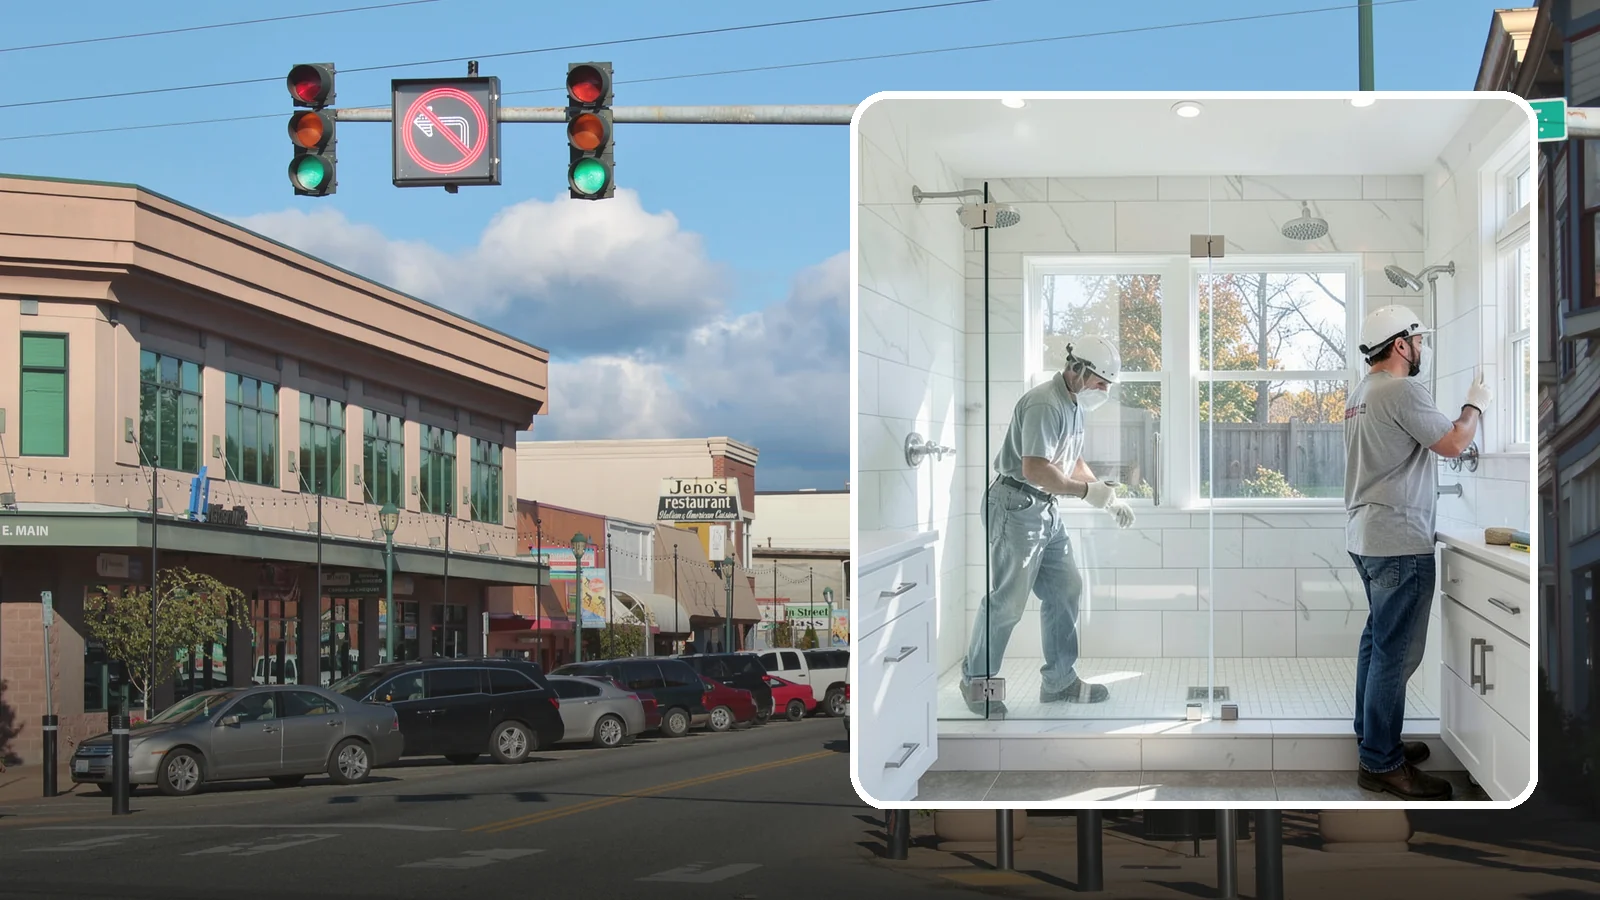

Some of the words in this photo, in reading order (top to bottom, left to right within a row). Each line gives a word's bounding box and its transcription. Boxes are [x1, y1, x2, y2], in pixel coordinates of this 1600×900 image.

[670, 480, 727, 494] Jeno's
[665, 496, 731, 509] restaurant
[659, 510, 681, 519] Italian
[686, 510, 714, 519] American
[715, 510, 737, 519] Cuisine
[2, 525, 13, 536] E.
[15, 525, 49, 536] MAIN
[797, 607, 828, 617] Street
[791, 619, 824, 627] lass
